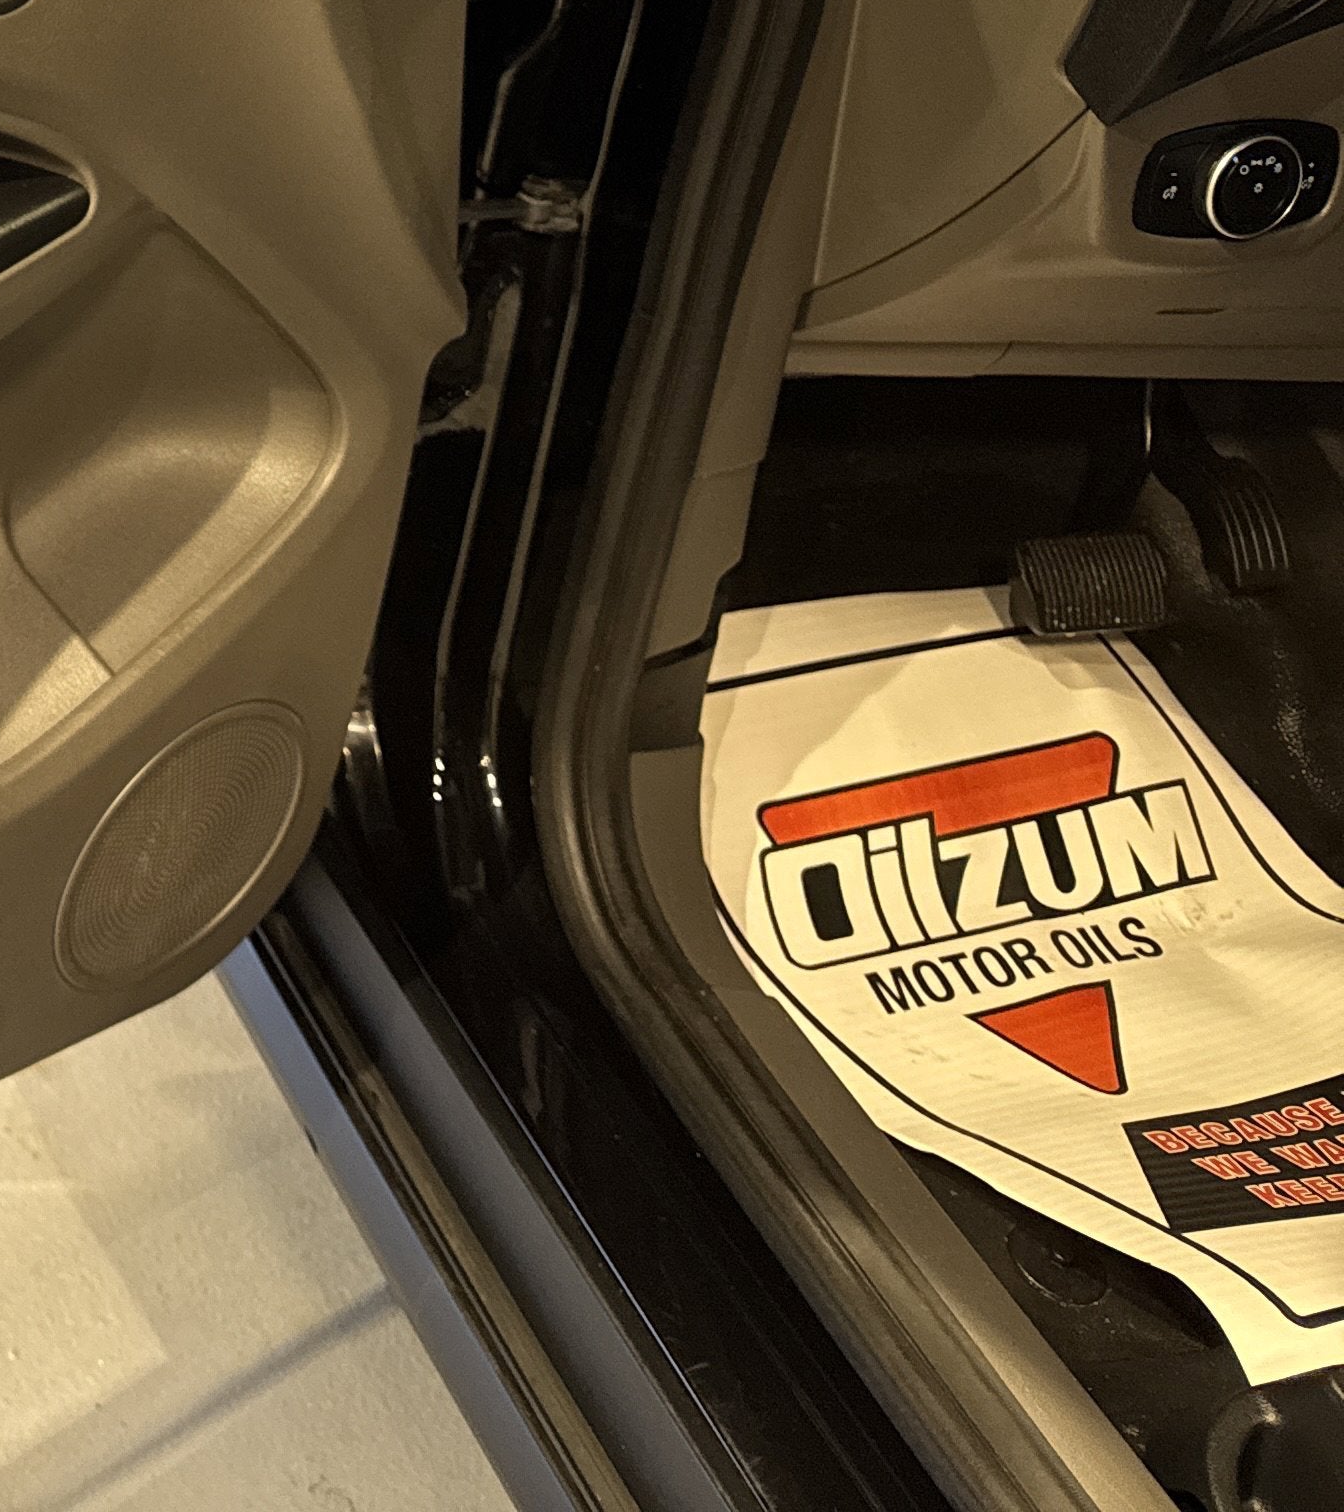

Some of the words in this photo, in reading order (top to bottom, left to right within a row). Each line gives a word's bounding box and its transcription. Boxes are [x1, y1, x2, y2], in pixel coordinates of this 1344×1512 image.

[865, 936, 1055, 1015] MOTOR
[1050, 916, 1164, 968] OILS
[1141, 1096, 1344, 1155] BECAUSE
[1189, 1150, 1282, 1181] WE
[1268, 1135, 1344, 1170] WA
[1244, 1172, 1344, 1209] KEE
